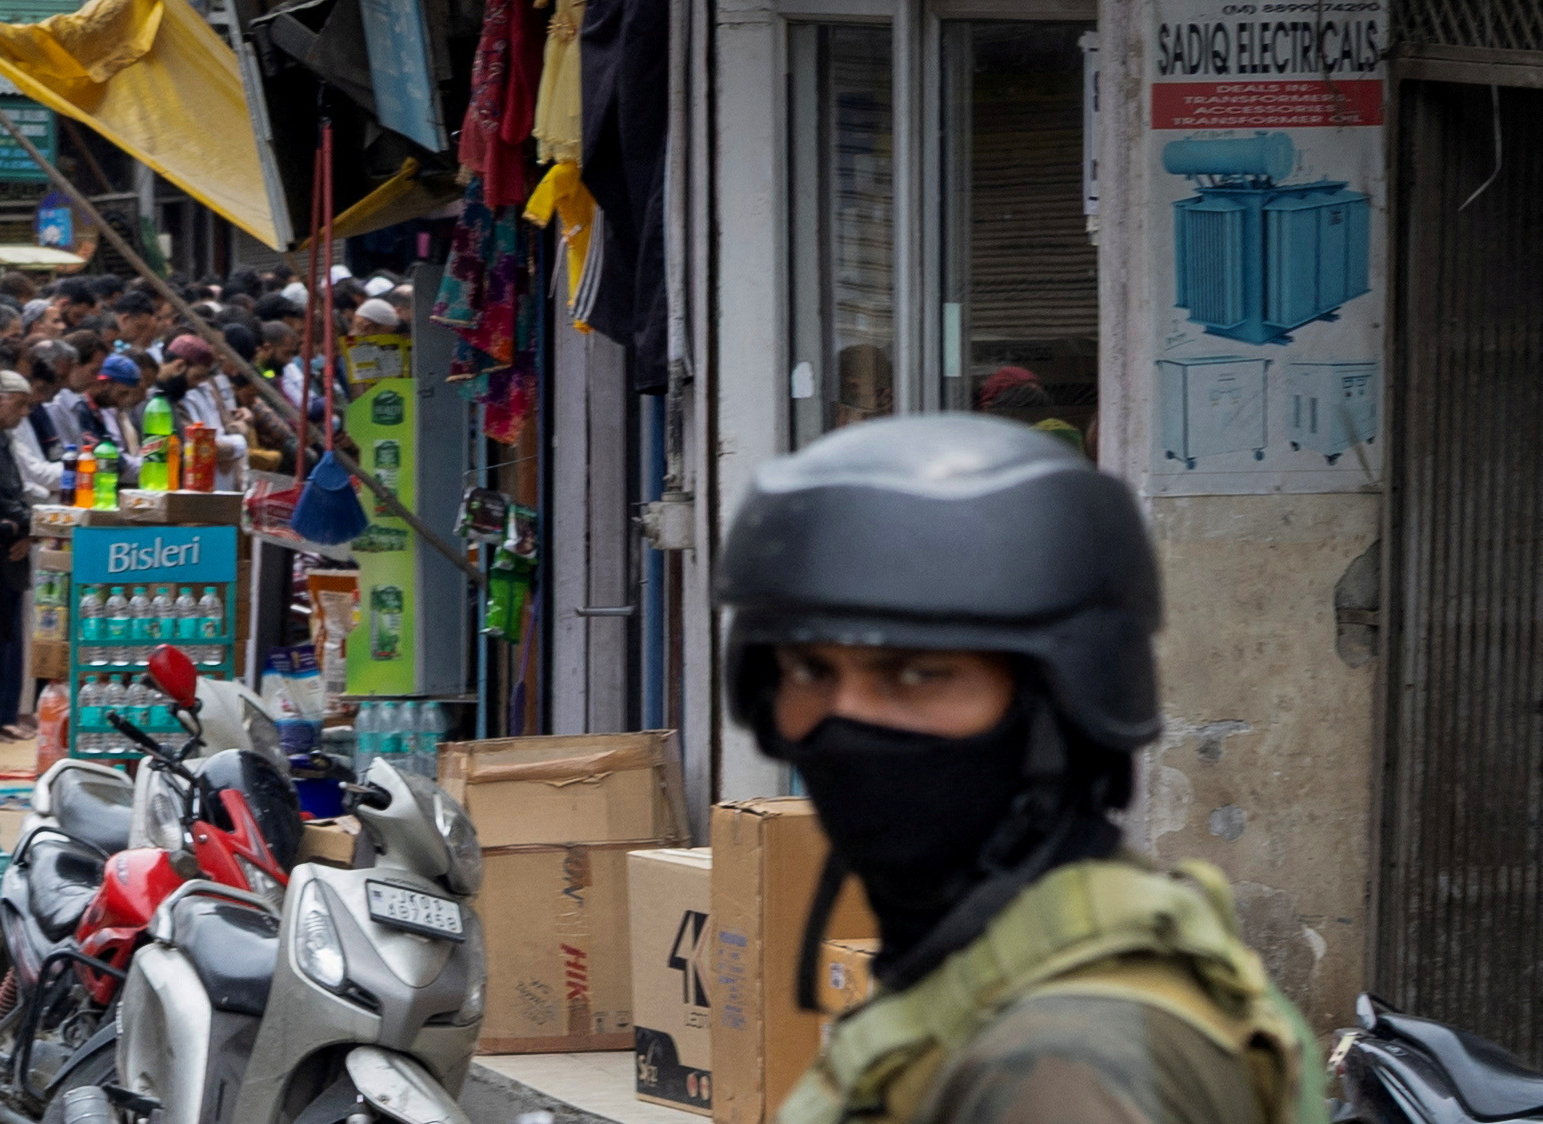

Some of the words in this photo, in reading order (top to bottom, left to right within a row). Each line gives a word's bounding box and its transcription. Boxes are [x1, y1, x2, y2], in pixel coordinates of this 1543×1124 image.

[1157, 22, 1231, 75] SADIQ
[1236, 20, 1380, 74] ELECTRICALS
[1216, 84, 1281, 93] DEALS
[1171, 115, 1324, 126] TRANSFORMER
[108, 536, 201, 574] Bisleri
